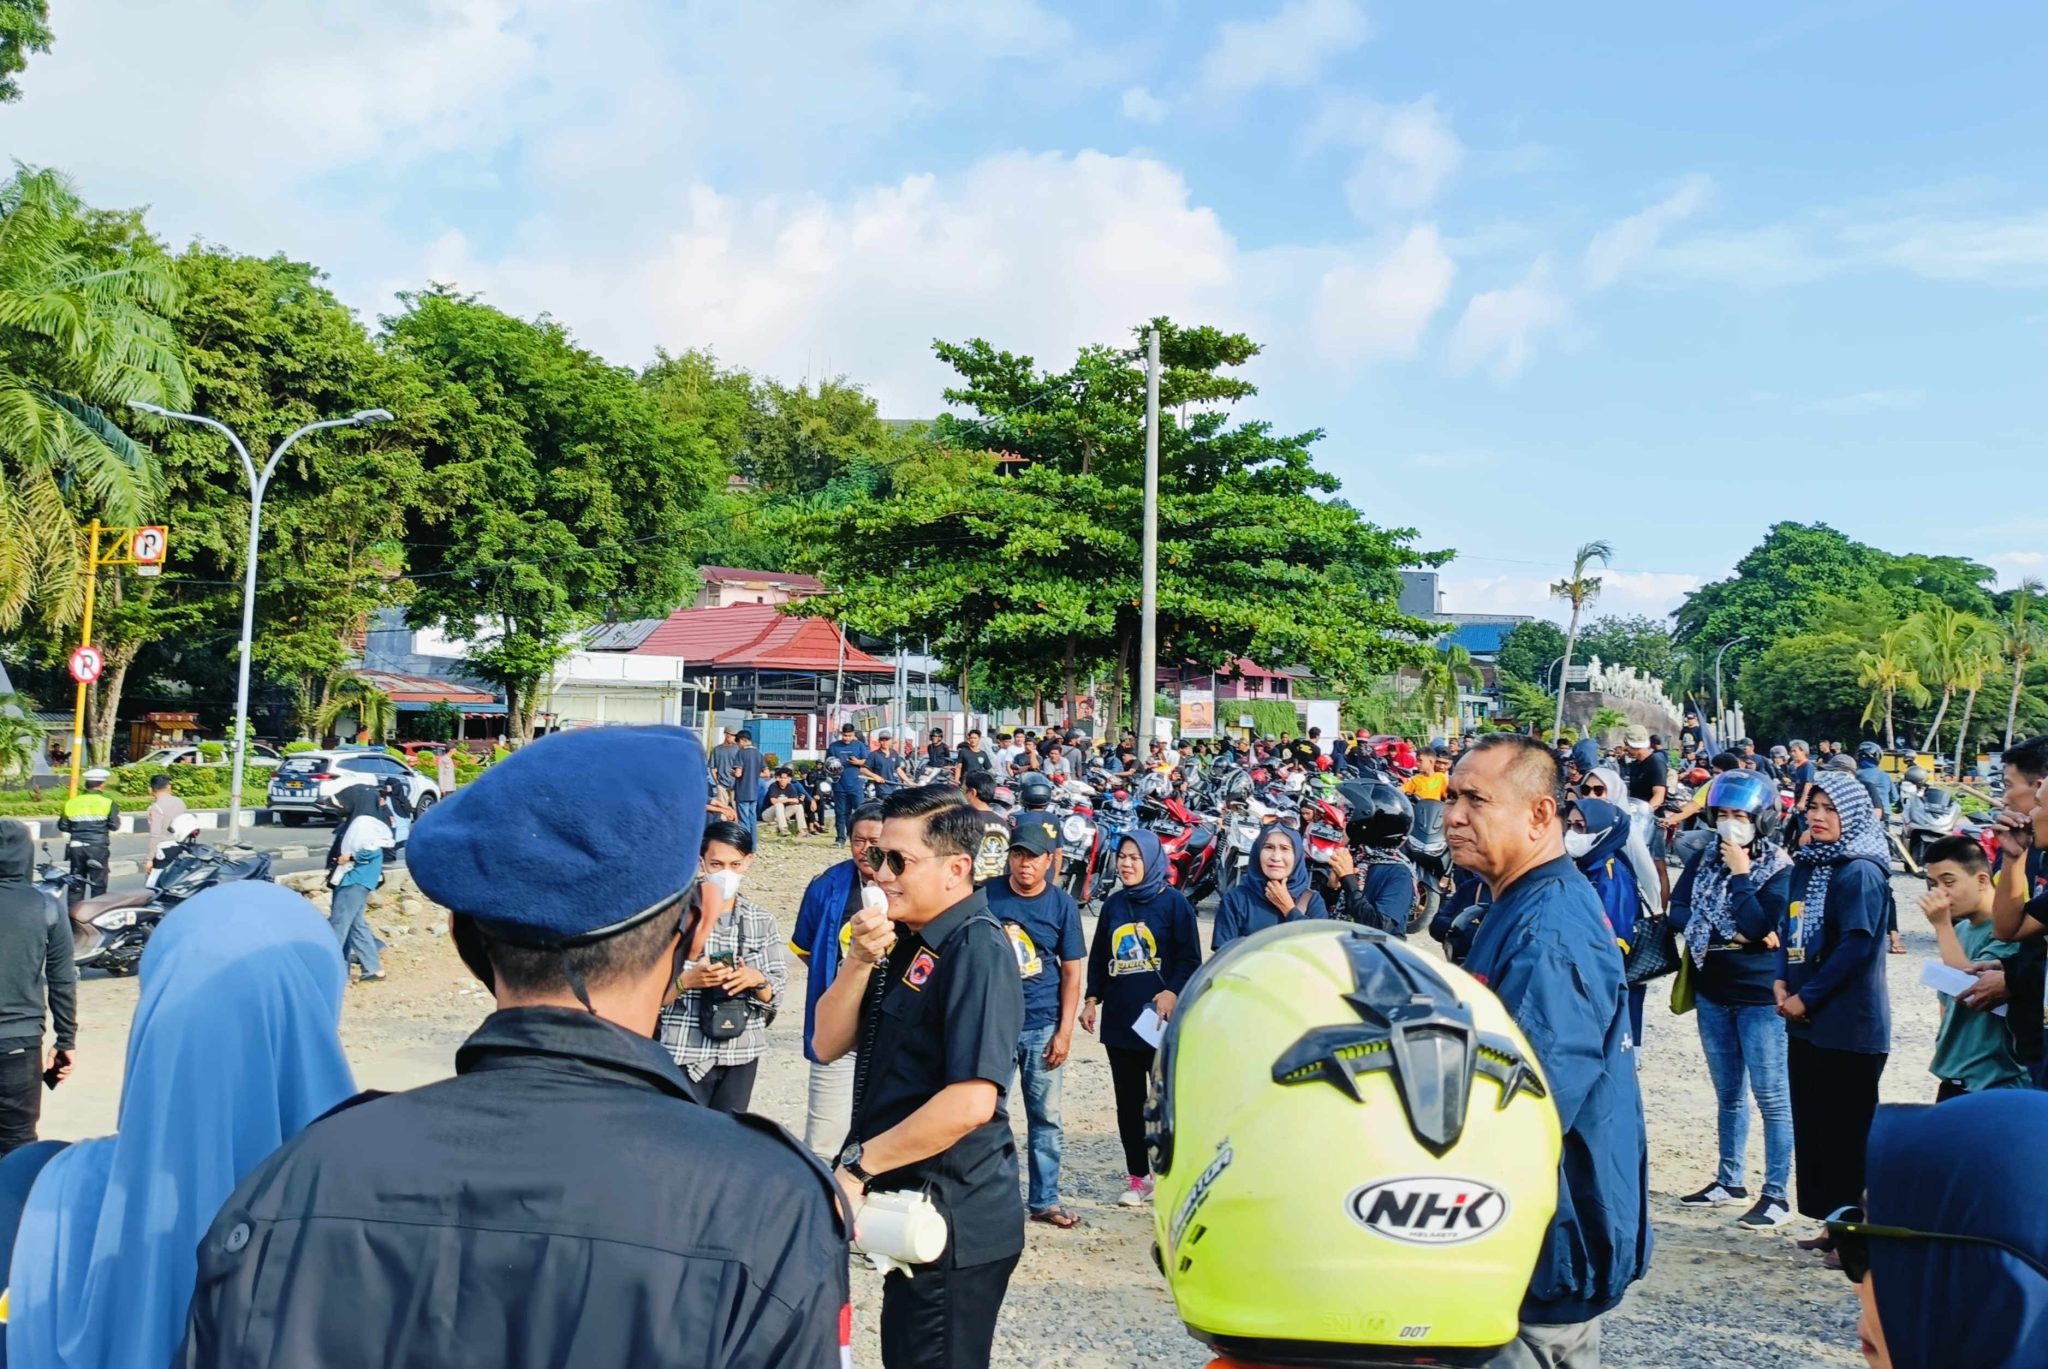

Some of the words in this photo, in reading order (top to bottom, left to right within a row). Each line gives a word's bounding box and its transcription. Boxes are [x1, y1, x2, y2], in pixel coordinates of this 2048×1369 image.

[144, 534, 156, 555] P
[82, 655, 93, 676] P
[1364, 1189, 1495, 1229] NHK
[1399, 1326, 1431, 1338] DOT
